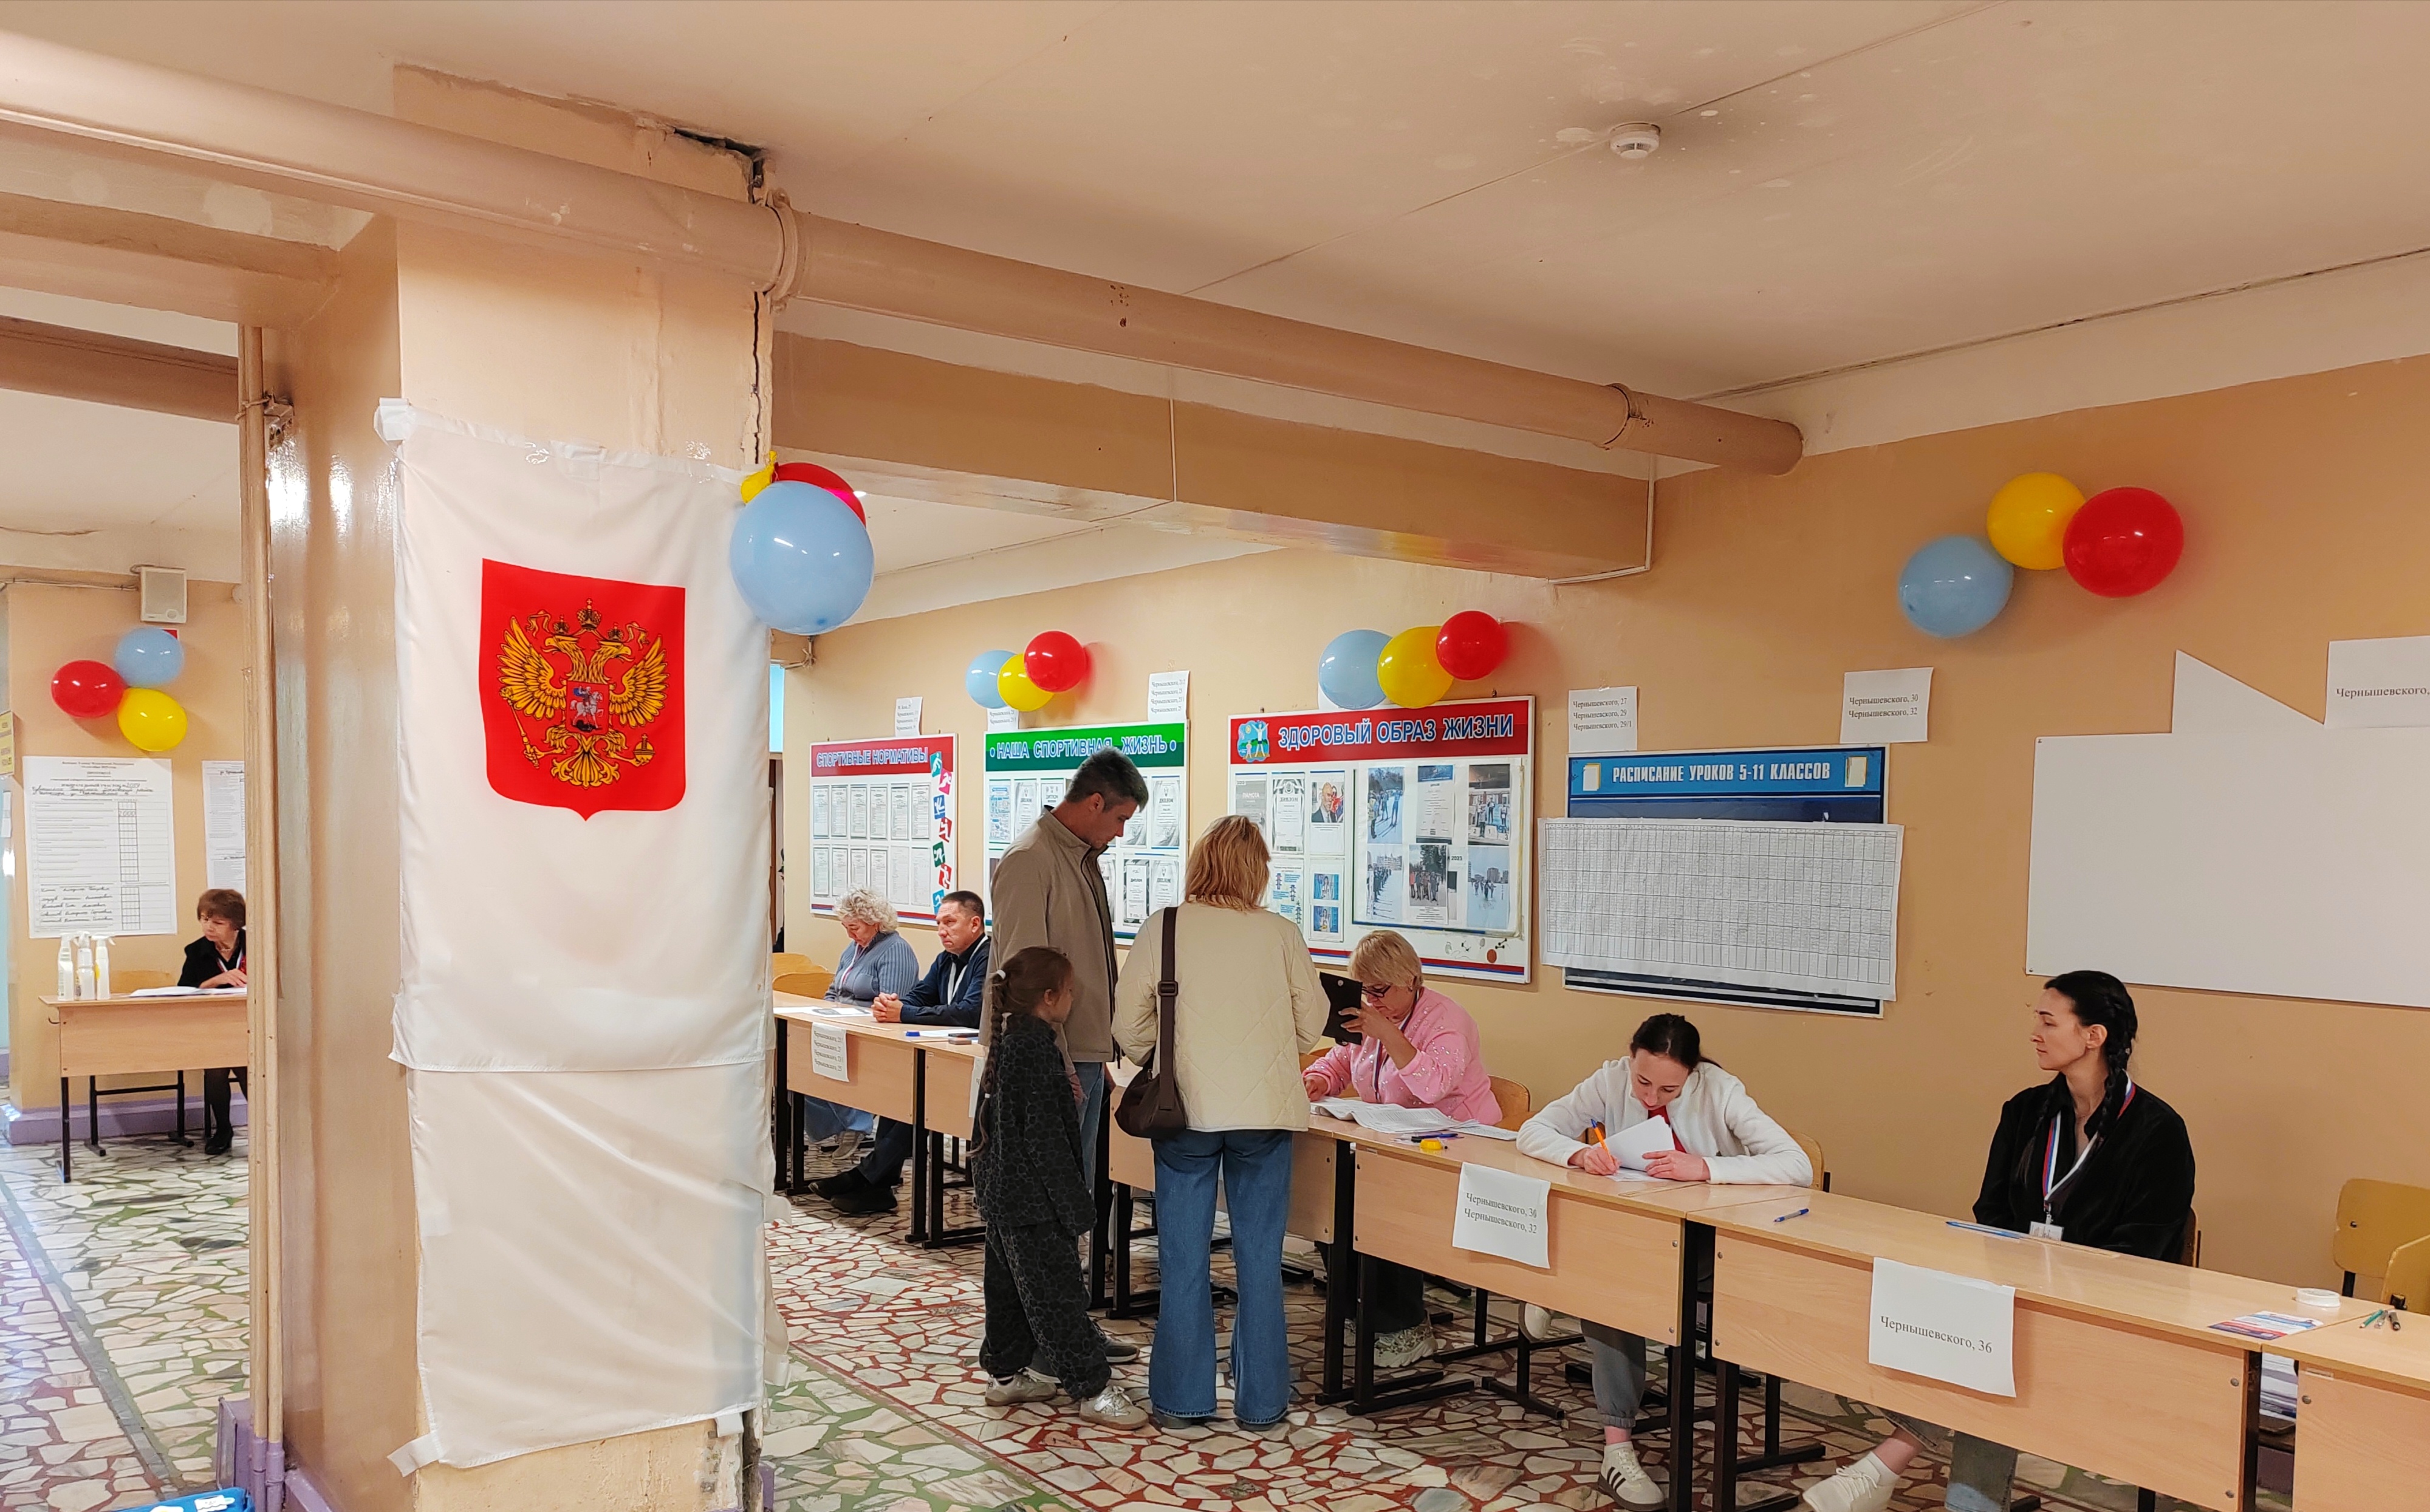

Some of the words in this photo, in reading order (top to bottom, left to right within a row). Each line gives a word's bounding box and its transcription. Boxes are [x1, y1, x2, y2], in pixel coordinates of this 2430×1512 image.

[1849, 696, 1909, 706] Чернышевского,
[1911, 694, 1918, 702] 30
[2336, 687, 2430, 699] Чернышевского,
[1573, 699, 1620, 709] Чернышевского,
[1573, 711, 1620, 720] Чернышевского,
[1849, 710, 1909, 719] Чернышевского,
[1278, 718, 1372, 751] ЗДОРОВЫЙ
[1377, 718, 1436, 744] ОБРАЗ
[1442, 713, 1514, 741] ЖИЗНИ
[1573, 722, 1619, 731] Чернышевского,
[997, 742, 1030, 759] НАША
[1033, 737, 1112, 758] СПОРТИВНАЯ
[1121, 734, 1167, 755] ЖИЗНЬ
[816, 749, 871, 767] СПОРТИВНЫЕ
[872, 747, 928, 765] НОРМАТИВЫ
[1612, 765, 1685, 783] РАСПИСАНИЕ
[1689, 764, 1734, 782] УРОКОВ
[1739, 763, 1764, 781] 5-11
[1770, 762, 1830, 780] КЛАССОВ
[1466, 1192, 1527, 1217] Чернышевского,
[1528, 1208, 1537, 1218] 30
[1464, 1208, 1527, 1232] Чернышевского,
[1528, 1223, 1537, 1234] 32
[1880, 1316, 1975, 1351] Чернышевского,
[1978, 1339, 1992, 1353] 36
